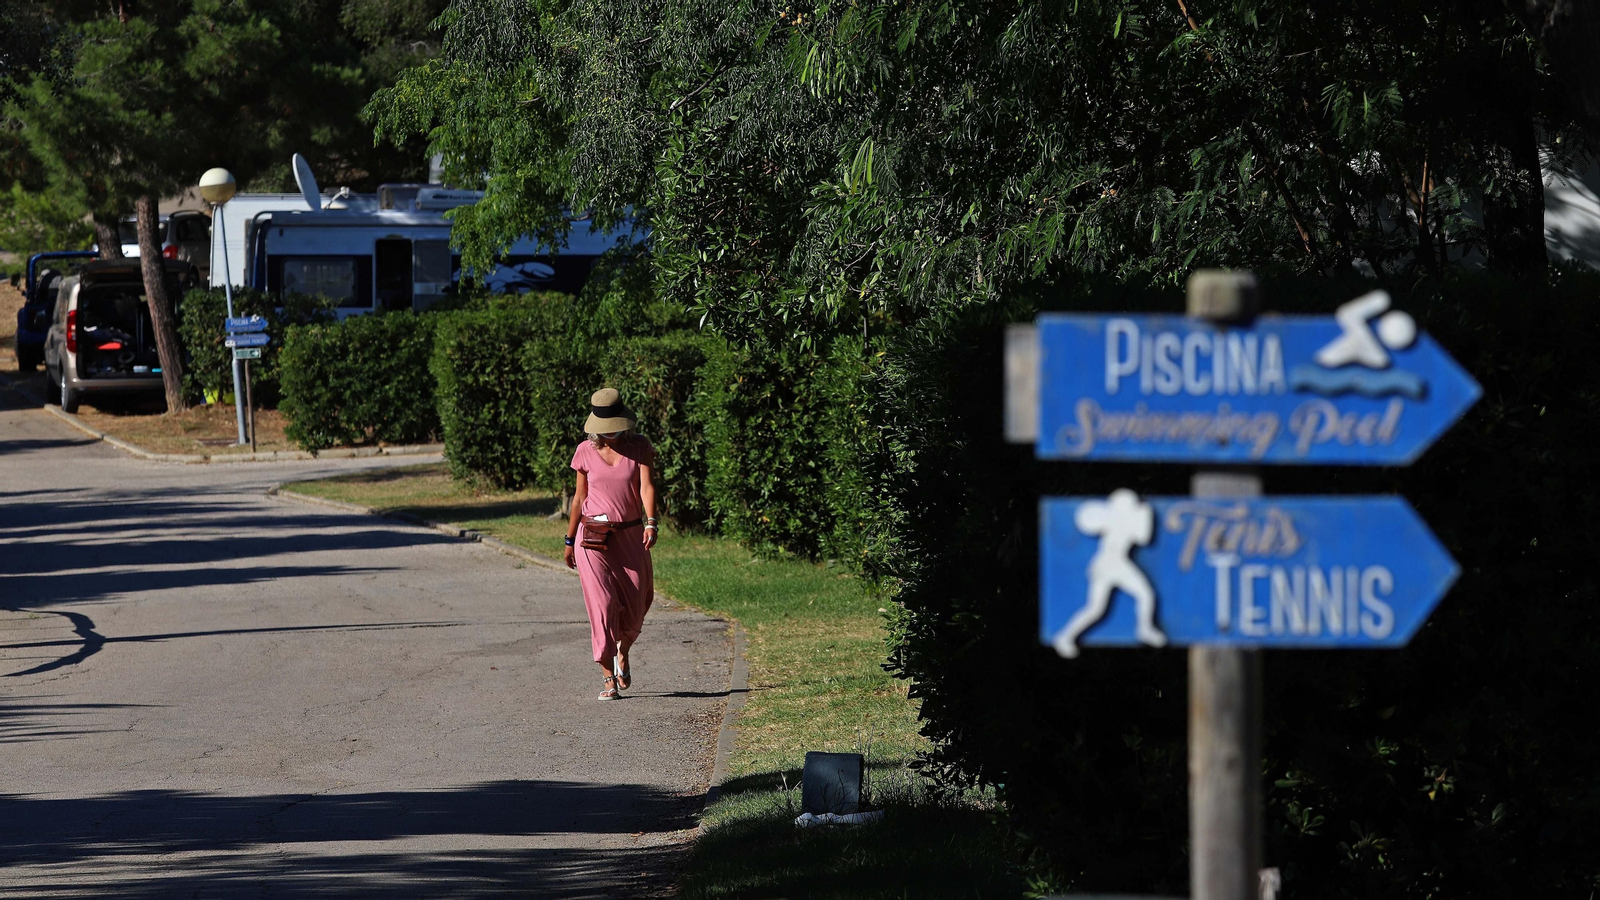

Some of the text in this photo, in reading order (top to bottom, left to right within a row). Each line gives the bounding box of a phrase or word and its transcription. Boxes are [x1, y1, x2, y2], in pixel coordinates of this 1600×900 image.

[1104, 318, 1286, 396] PISCINA
[1056, 396, 1403, 459] Swimming Pool
[1163, 500, 1304, 573] Tenis
[1206, 551, 1395, 640] TENNIS
